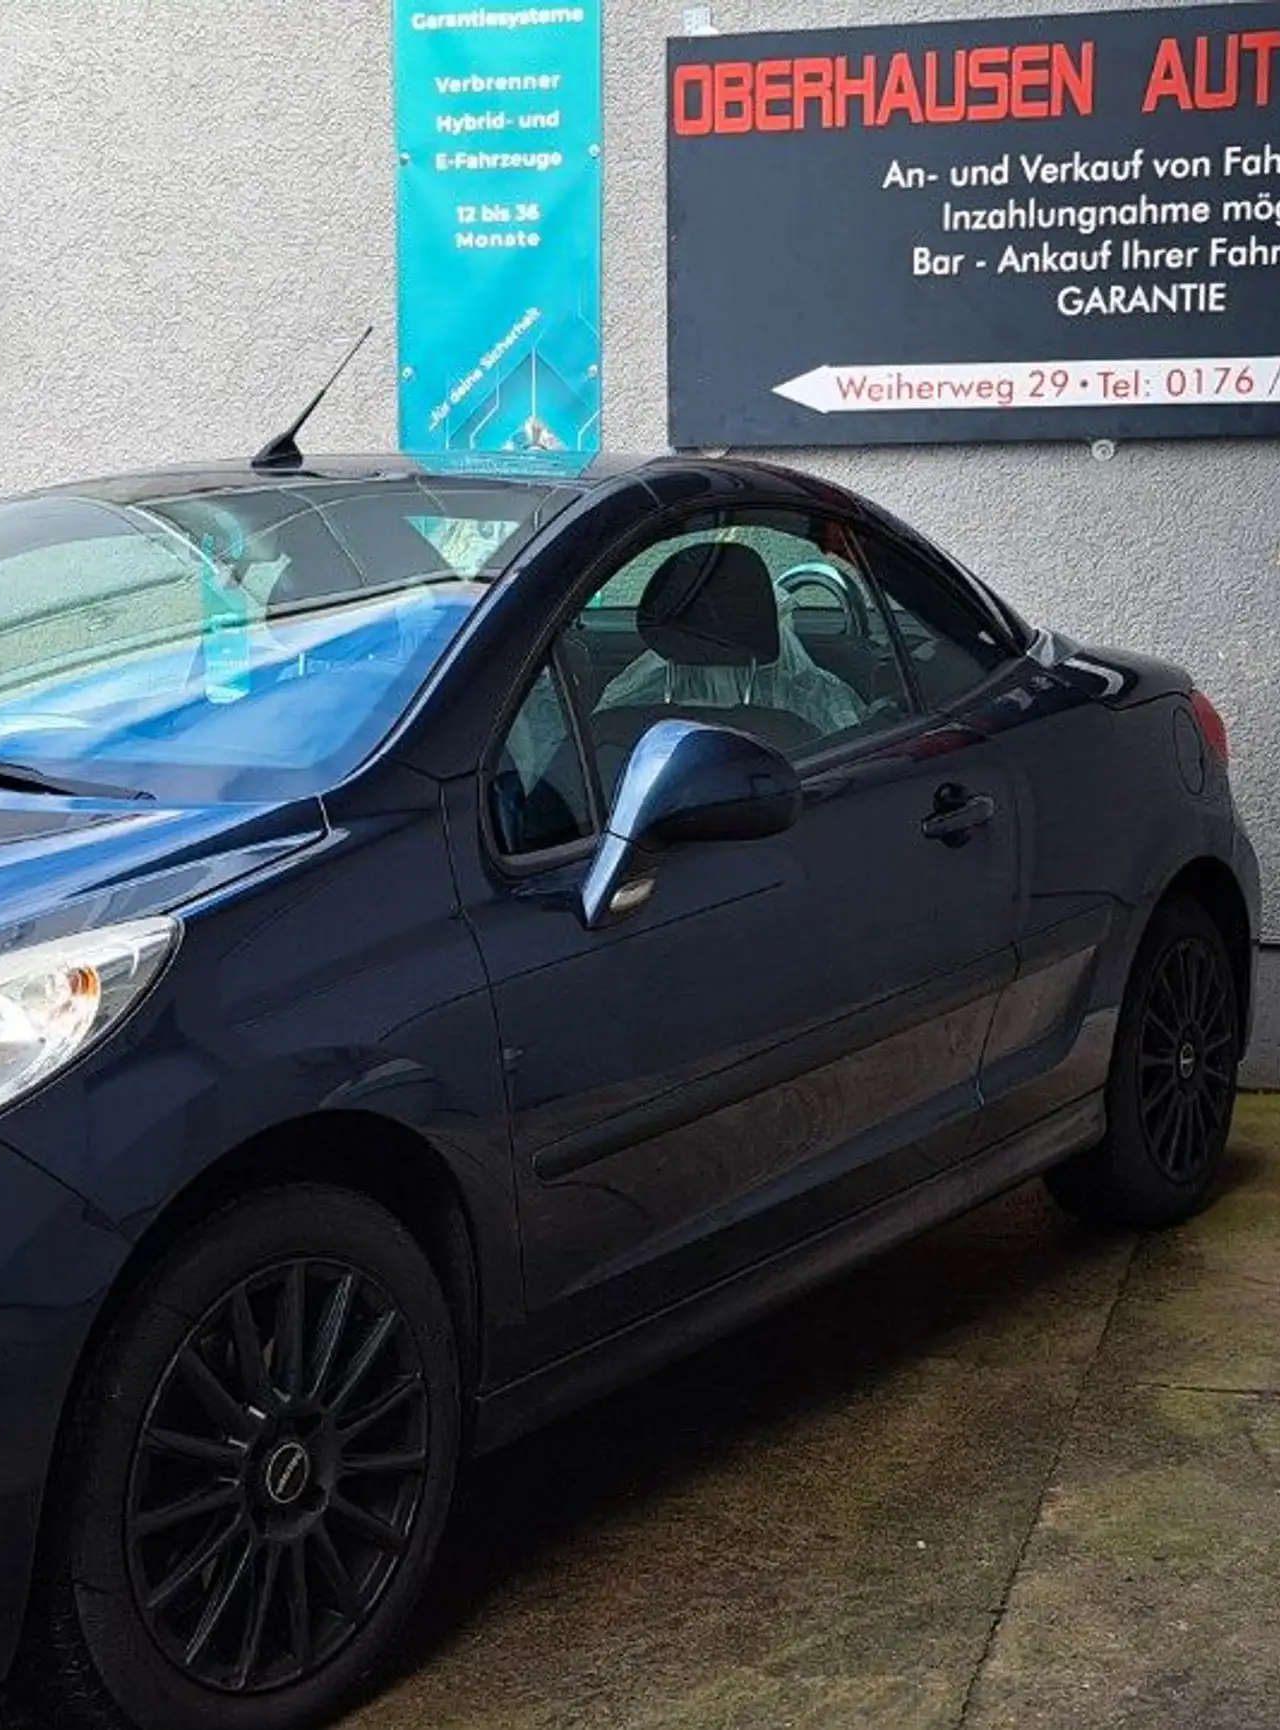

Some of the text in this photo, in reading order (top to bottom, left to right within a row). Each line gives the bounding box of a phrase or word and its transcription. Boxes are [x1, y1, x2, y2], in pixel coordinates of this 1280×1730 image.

[411, 7, 585, 30] Garantiesysteme
[434, 74, 562, 93] Verbrenner
[673, 41, 1095, 136] OBERHAUSEN
[436, 110, 560, 135] Hybrid- und
[435, 152, 563, 171] E-Fahrzeuge
[882, 160, 939, 189] An-
[950, 154, 1009, 187] und
[1020, 148, 1144, 183] Verkauf
[1152, 156, 1211, 180] von
[457, 203, 540, 223] 12 bis 36
[942, 193, 1211, 235] Inzahlungnahme
[455, 231, 541, 249] Monate
[912, 246, 965, 277] Bar
[997, 240, 1112, 274] Ankauf
[1122, 239, 1199, 271] Ihrer
[1057, 282, 1227, 317] GARANTIE
[836, 372, 1015, 405] Weiherweg
[1028, 368, 1069, 399] 29
[1096, 369, 1151, 399] Tel:
[1166, 364, 1254, 397] 0176
